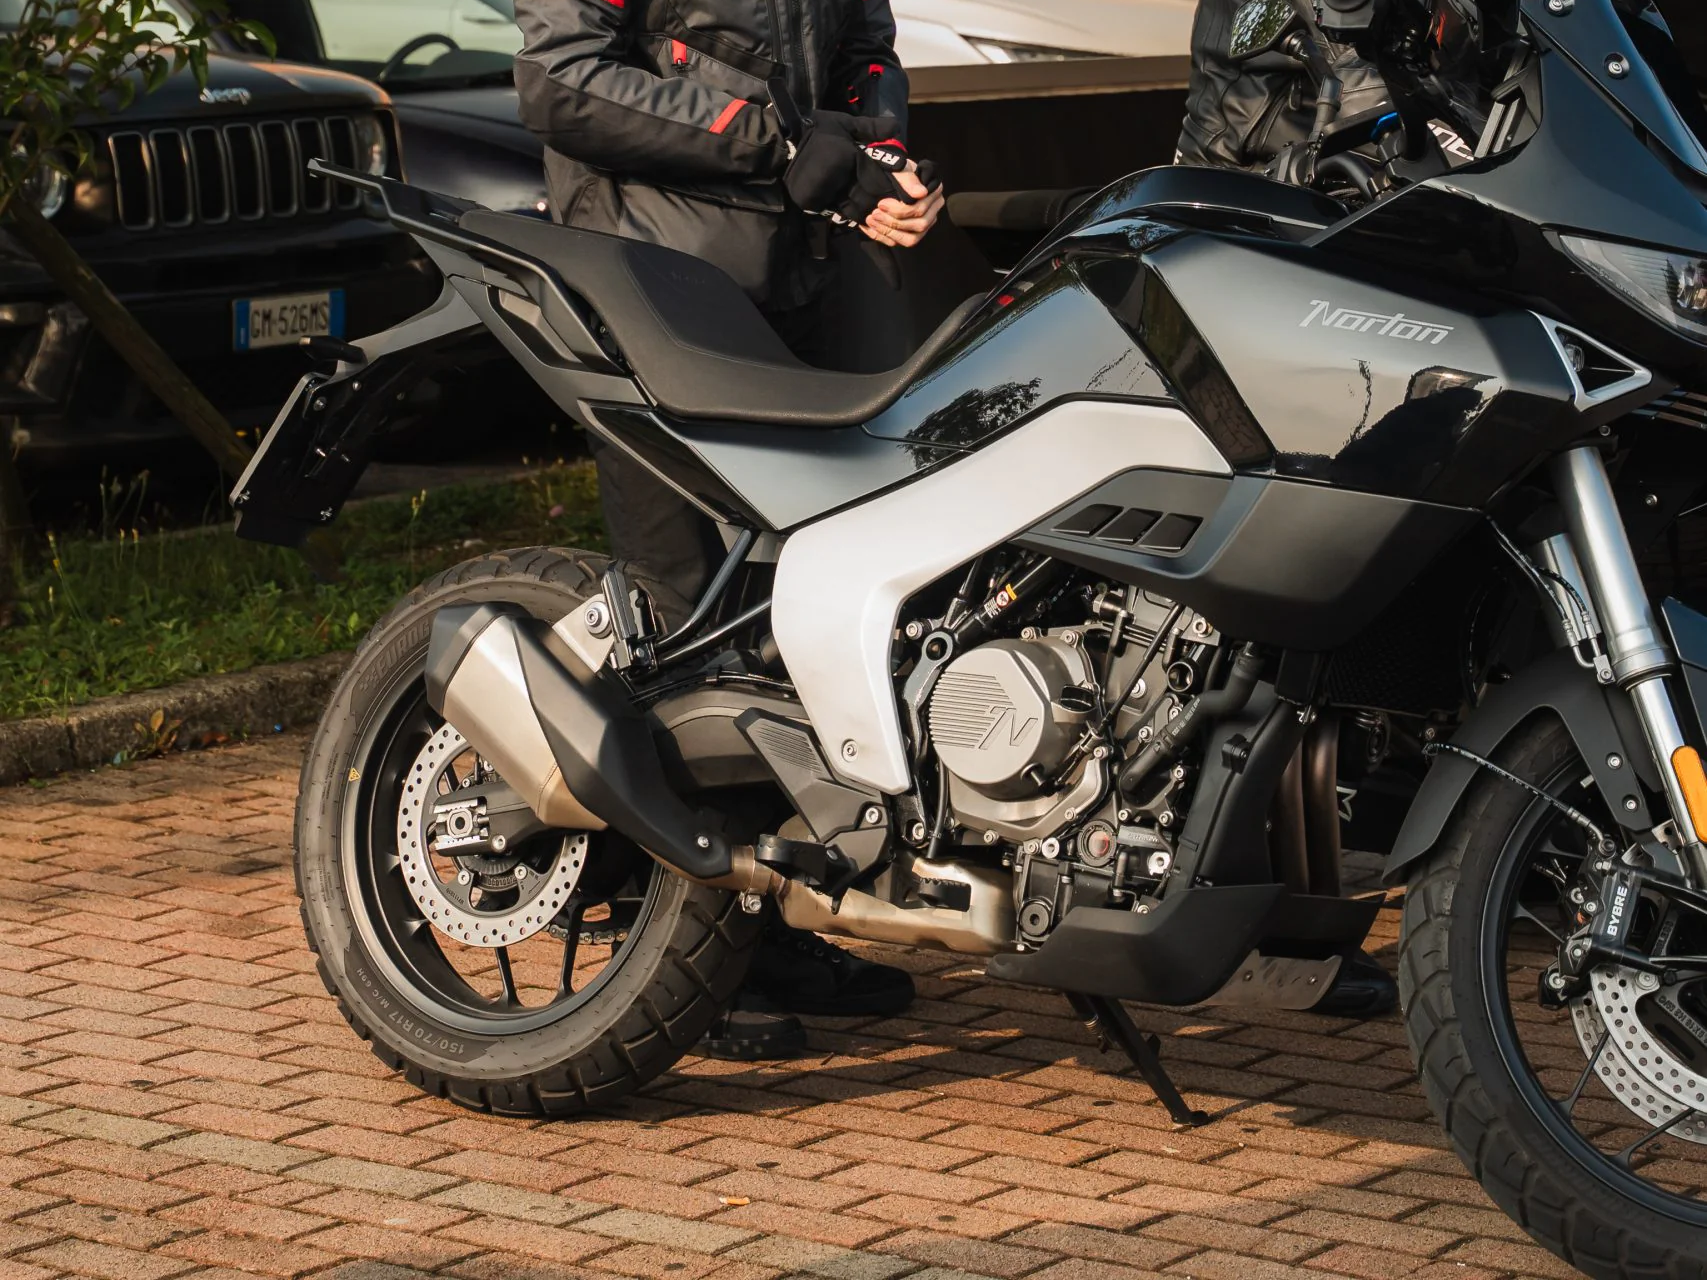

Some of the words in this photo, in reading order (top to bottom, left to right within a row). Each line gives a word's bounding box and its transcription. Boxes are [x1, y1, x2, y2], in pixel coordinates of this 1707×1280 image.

[1299, 299, 1455, 345] Norton
[1606, 885, 1628, 937] BYBRE
[389, 1011, 414, 1032] R17
[415, 1028, 464, 1054] 150/70
